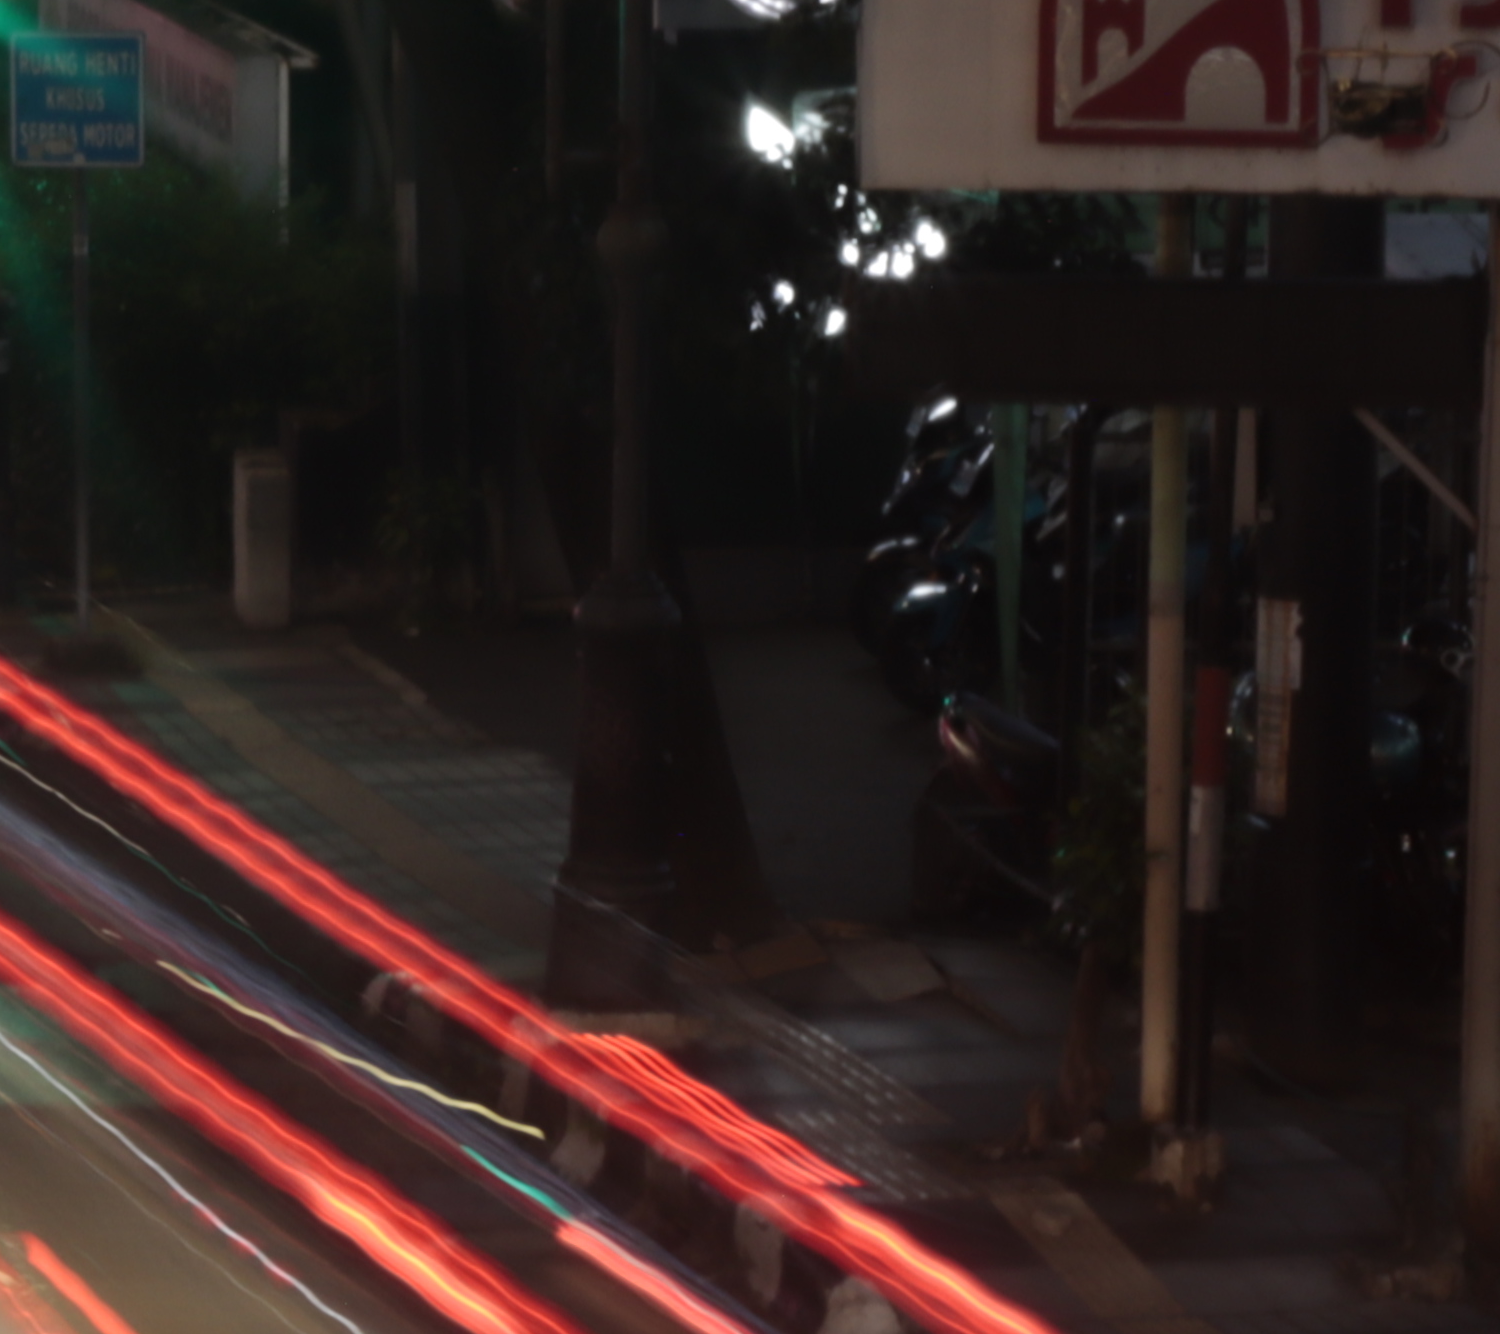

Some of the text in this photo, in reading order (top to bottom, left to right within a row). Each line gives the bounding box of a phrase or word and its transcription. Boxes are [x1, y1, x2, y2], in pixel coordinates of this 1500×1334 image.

[18, 49, 137, 77] RUANG HENTI
[44, 85, 106, 112] KHUSUS
[19, 121, 136, 148] SEPEDA MOTOR
